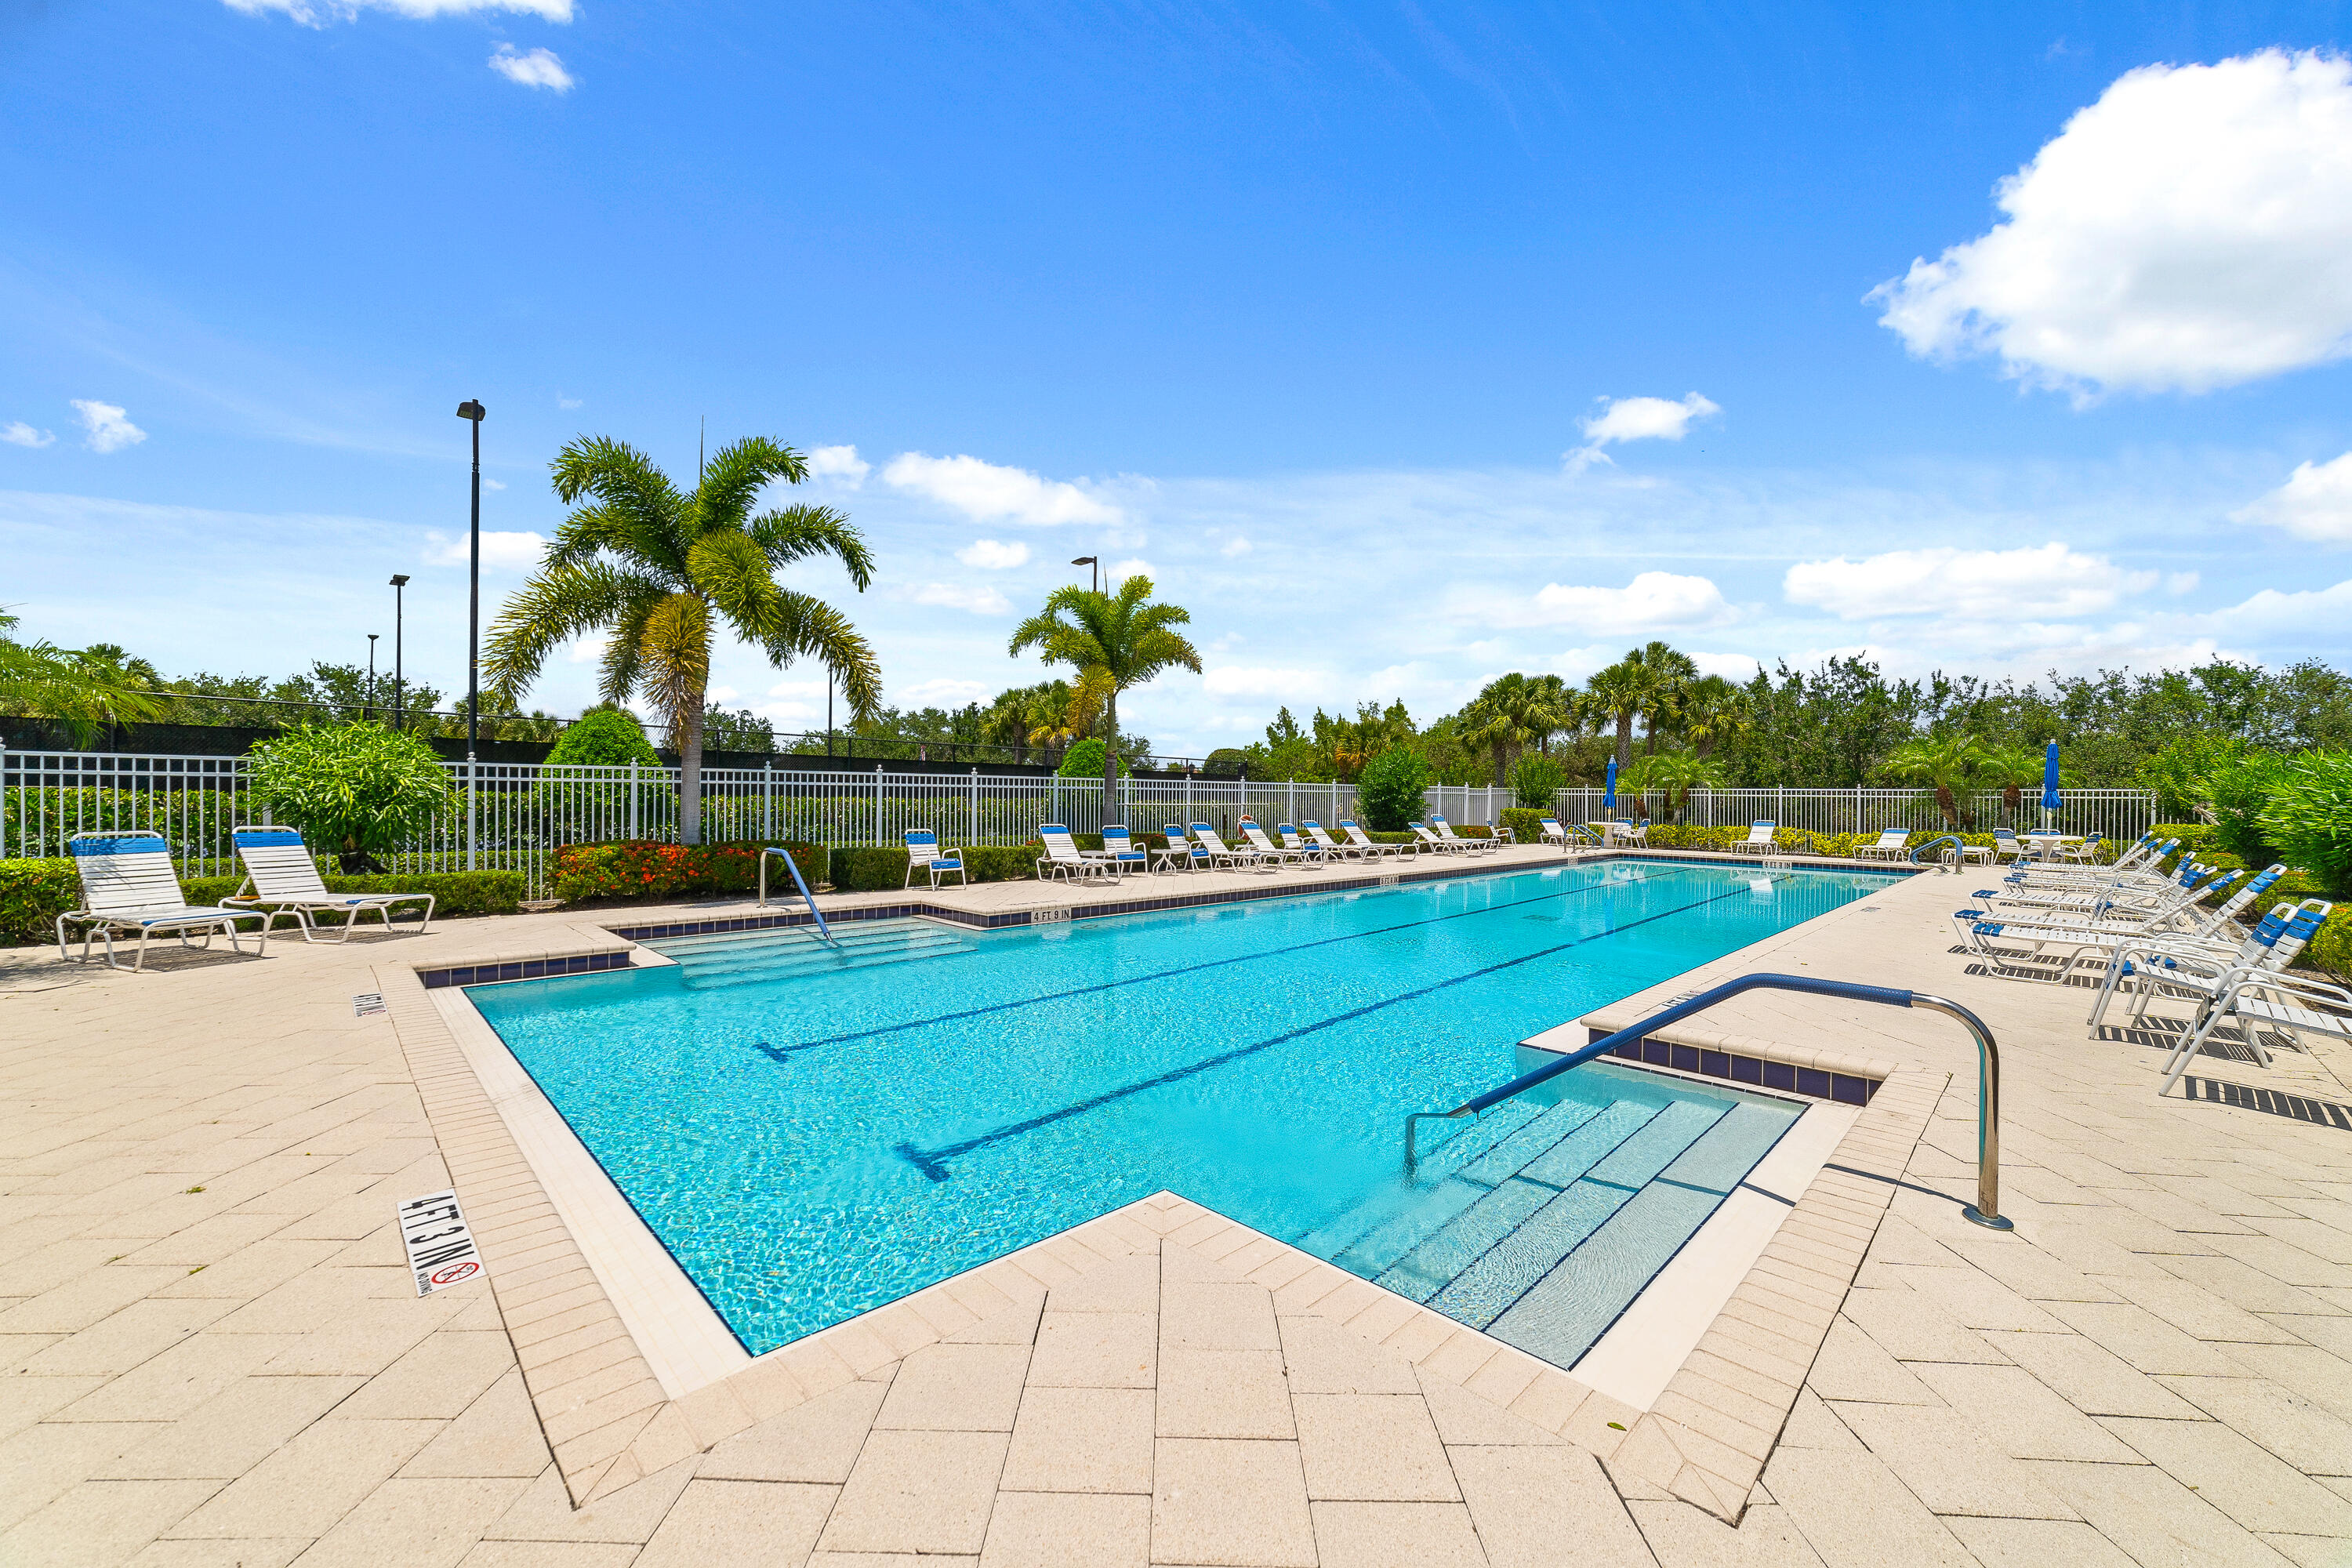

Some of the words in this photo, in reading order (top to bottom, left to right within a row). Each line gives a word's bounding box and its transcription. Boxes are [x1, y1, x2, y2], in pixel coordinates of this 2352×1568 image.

[1033, 912, 1040, 921] 4
[1042, 911, 1051, 921] FT
[1054, 910, 1059, 920] 9
[401, 1195, 454, 1211] 4
[404, 1204, 459, 1229] FT
[409, 1225, 465, 1244] 3
[413, 1238, 475, 1270] IN
[416, 1272, 428, 1280] NO
[418, 1278, 433, 1294] DIVING
